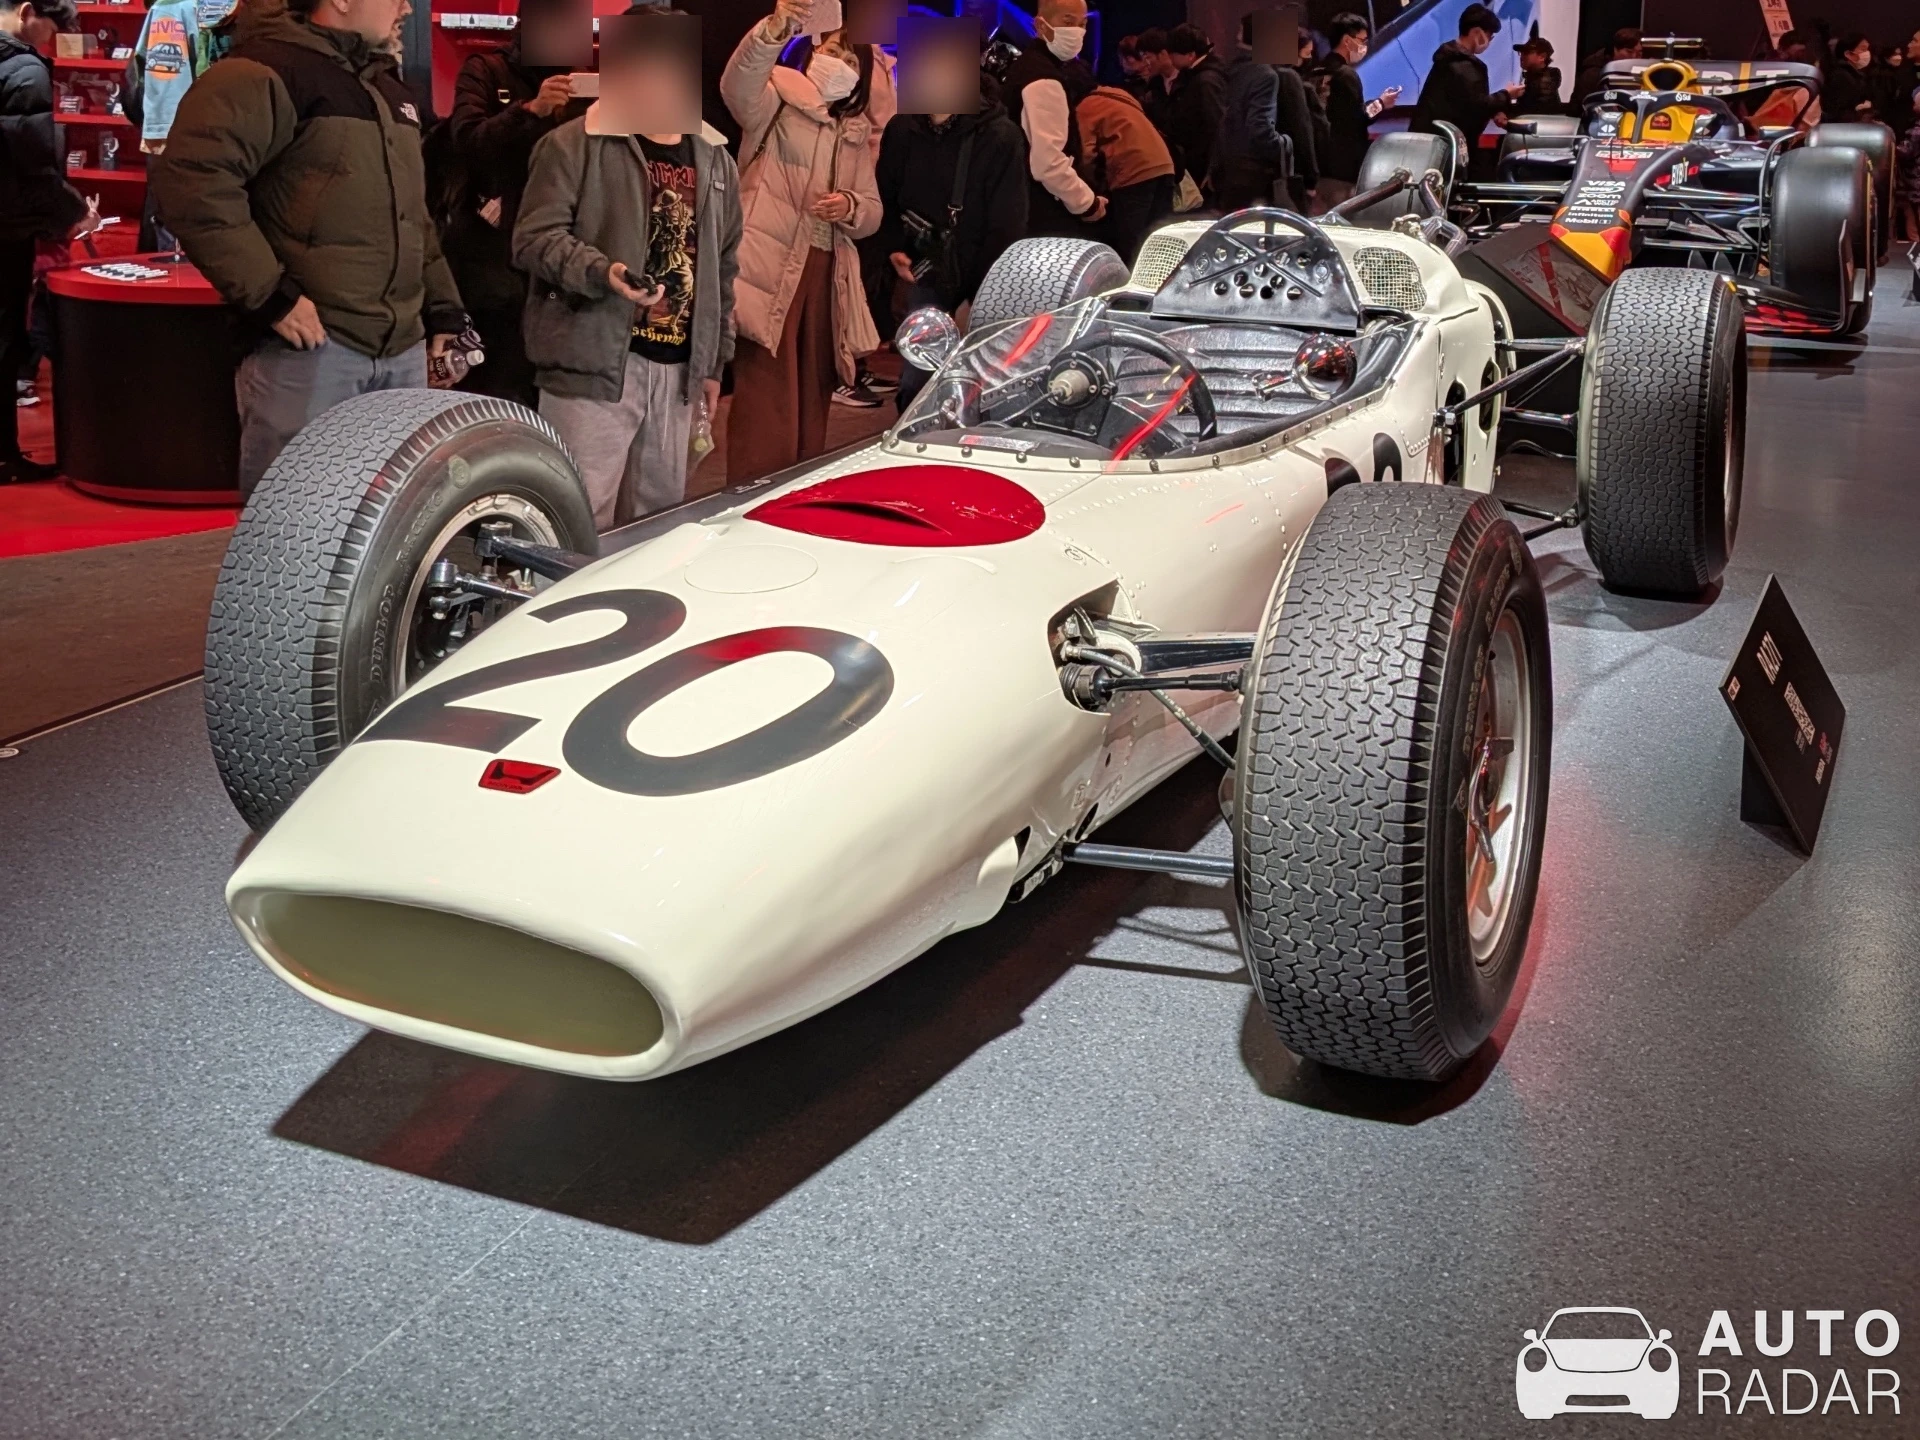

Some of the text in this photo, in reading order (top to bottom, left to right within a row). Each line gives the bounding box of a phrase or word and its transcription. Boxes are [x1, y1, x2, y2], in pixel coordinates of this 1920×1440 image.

[1565, 217, 1598, 225] Mobil
[370, 584, 395, 684] DUNLOP
[1756, 631, 1784, 685] RA271
[349, 588, 896, 797] 20
